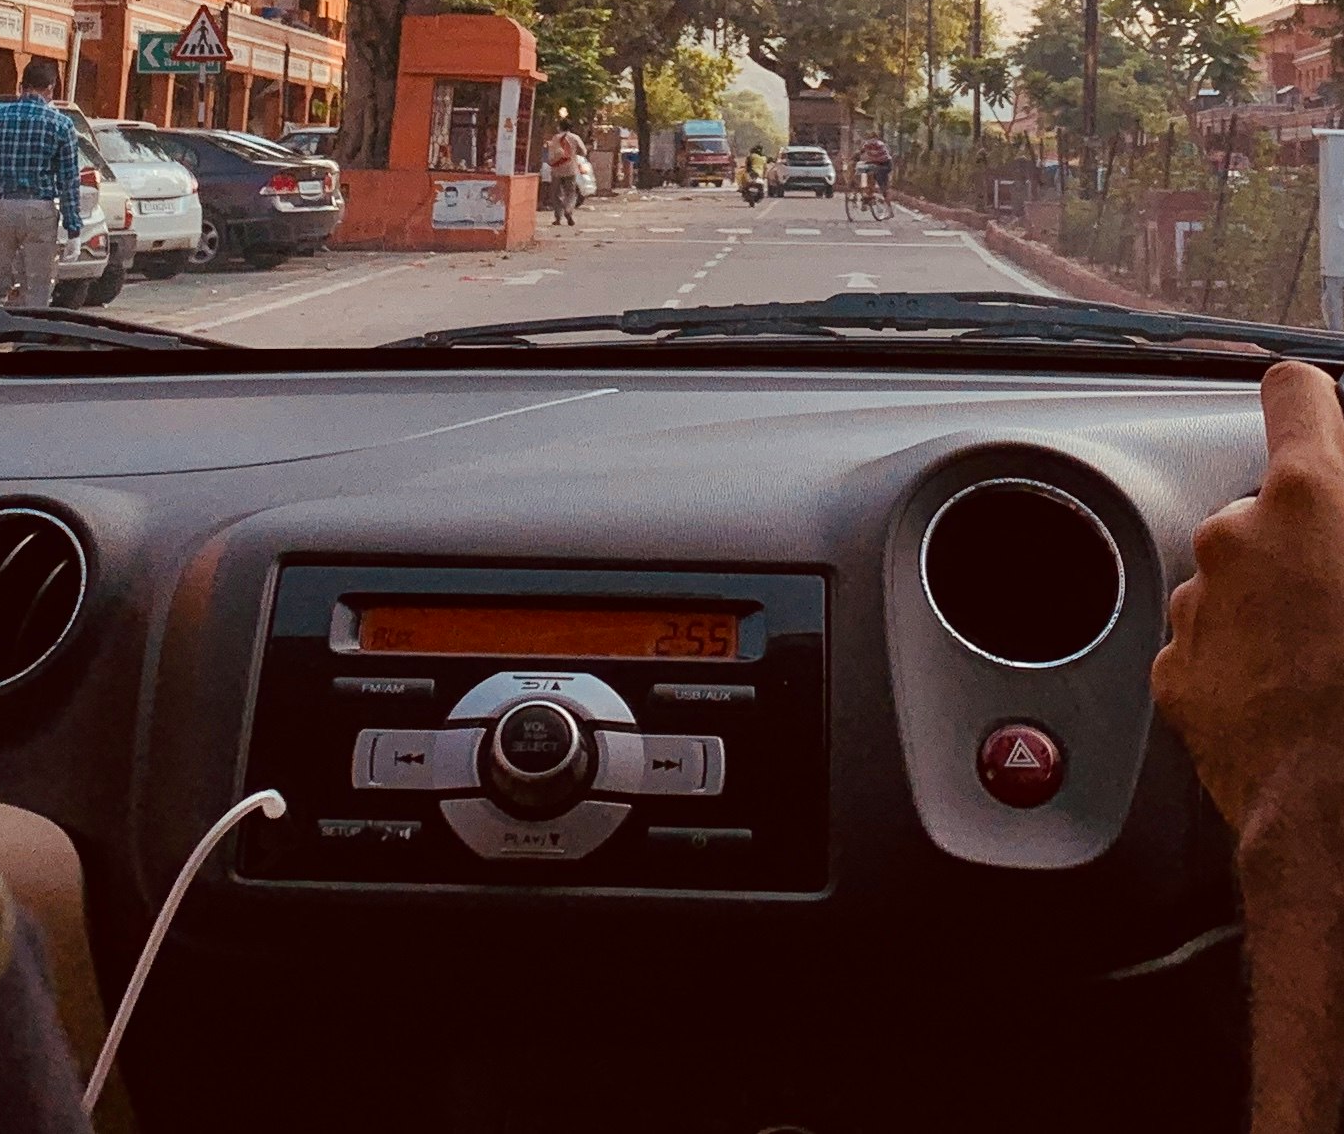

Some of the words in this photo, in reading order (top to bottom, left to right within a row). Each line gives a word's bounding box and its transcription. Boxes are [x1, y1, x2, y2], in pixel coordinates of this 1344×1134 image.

[361, 682, 405, 694] FM/AM
[674, 691, 731, 702] USB/AUX
[523, 721, 548, 733] VOL
[512, 741, 559, 752] SELECT
[321, 825, 361, 837] SETUP
